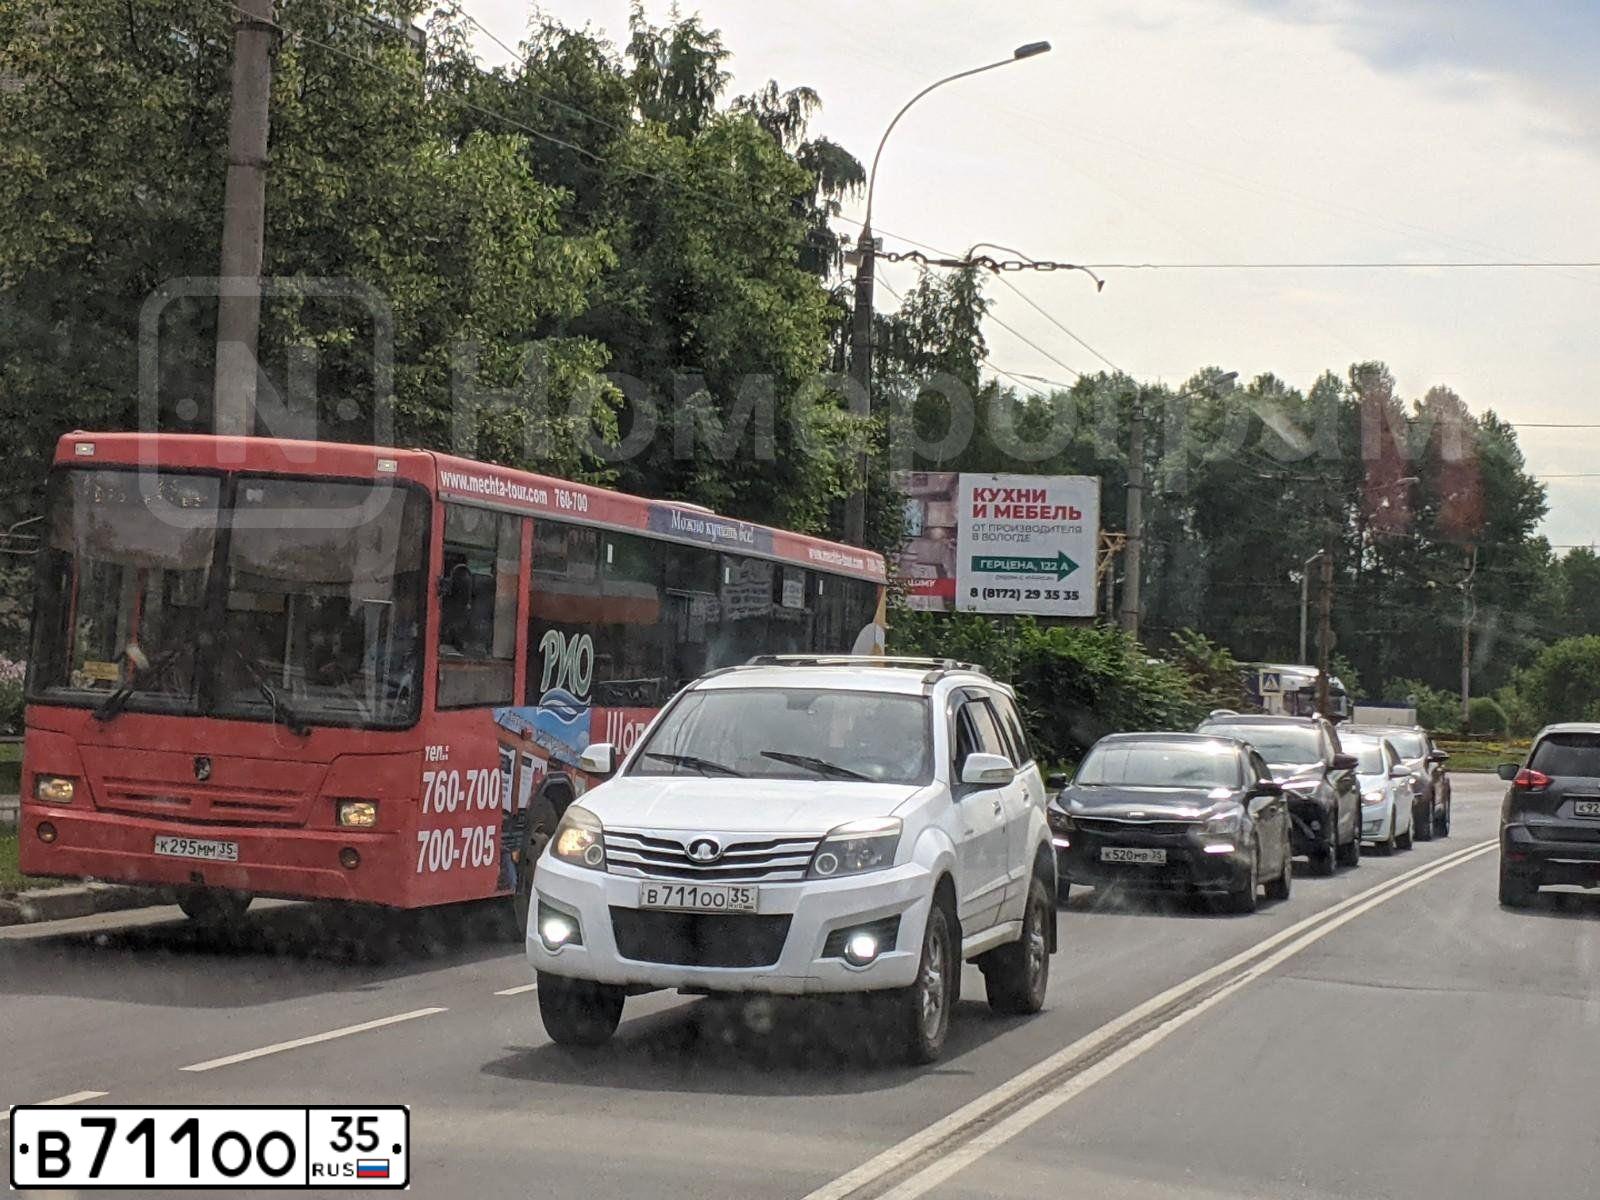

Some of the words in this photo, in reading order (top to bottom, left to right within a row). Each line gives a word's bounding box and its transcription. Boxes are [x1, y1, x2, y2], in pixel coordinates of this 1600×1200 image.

[438, 470, 548, 505] www.mechta-tour.com
[554, 488, 588, 513] 760-700
[973, 487, 1047, 503] КУХНИ
[972, 504, 987, 518] И
[993, 504, 1082, 520] МЕБЕЛЬ
[671, 509, 704, 534] Можно
[972, 523, 986, 532] ОТ
[988, 524, 1082, 534] ПРОИЗВОДИТЕЛЯ
[972, 532, 979, 541] В
[981, 533, 1031, 542] ВОЛОГДЕ
[980, 559, 1038, 571] ГЕРЦЕНА,
[1041, 561, 1058, 571] 122
[1060, 562, 1070, 571] А
[970, 587, 978, 598] 8
[982, 587, 1021, 601] (8172)
[1024, 589, 1040, 600] 29
[1044, 590, 1060, 600] 35
[1063, 590, 1080, 601] 35
[539, 629, 594, 696] РИО
[422, 768, 500, 814] 760-700
[160, 839, 216, 856] К295ММ
[416, 825, 496, 873] 700-705
[647, 885, 725, 907] В711ОО
[731, 888, 750, 904] 35
